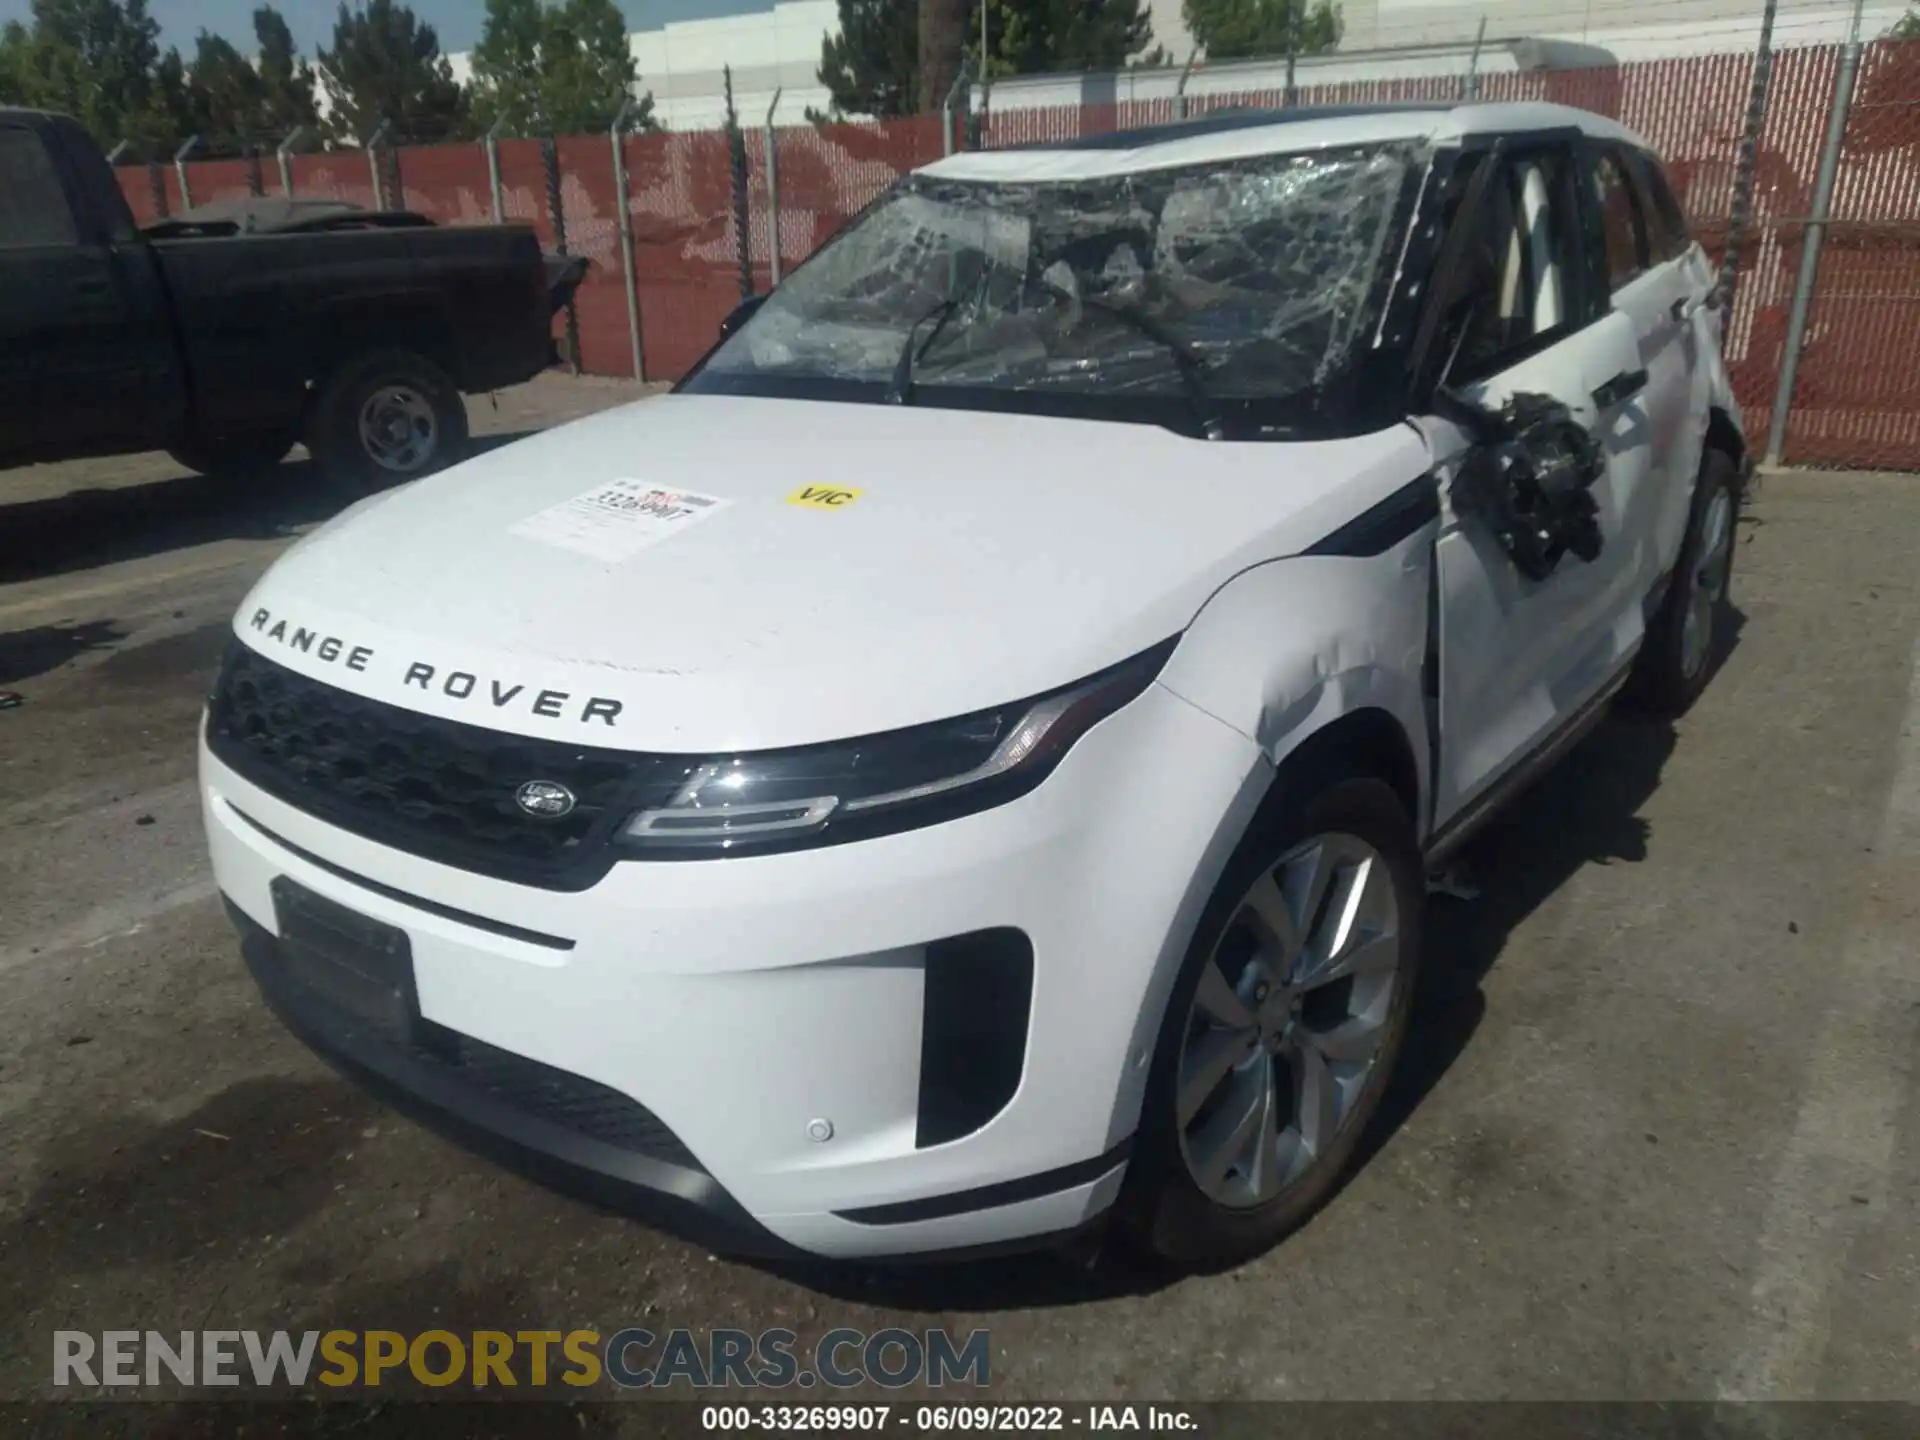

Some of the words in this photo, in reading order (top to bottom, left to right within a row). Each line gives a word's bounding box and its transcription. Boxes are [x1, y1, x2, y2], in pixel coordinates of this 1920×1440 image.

[799, 486, 854, 505] VIC
[250, 607, 374, 672] RANGE
[403, 662, 624, 726] ROVER
